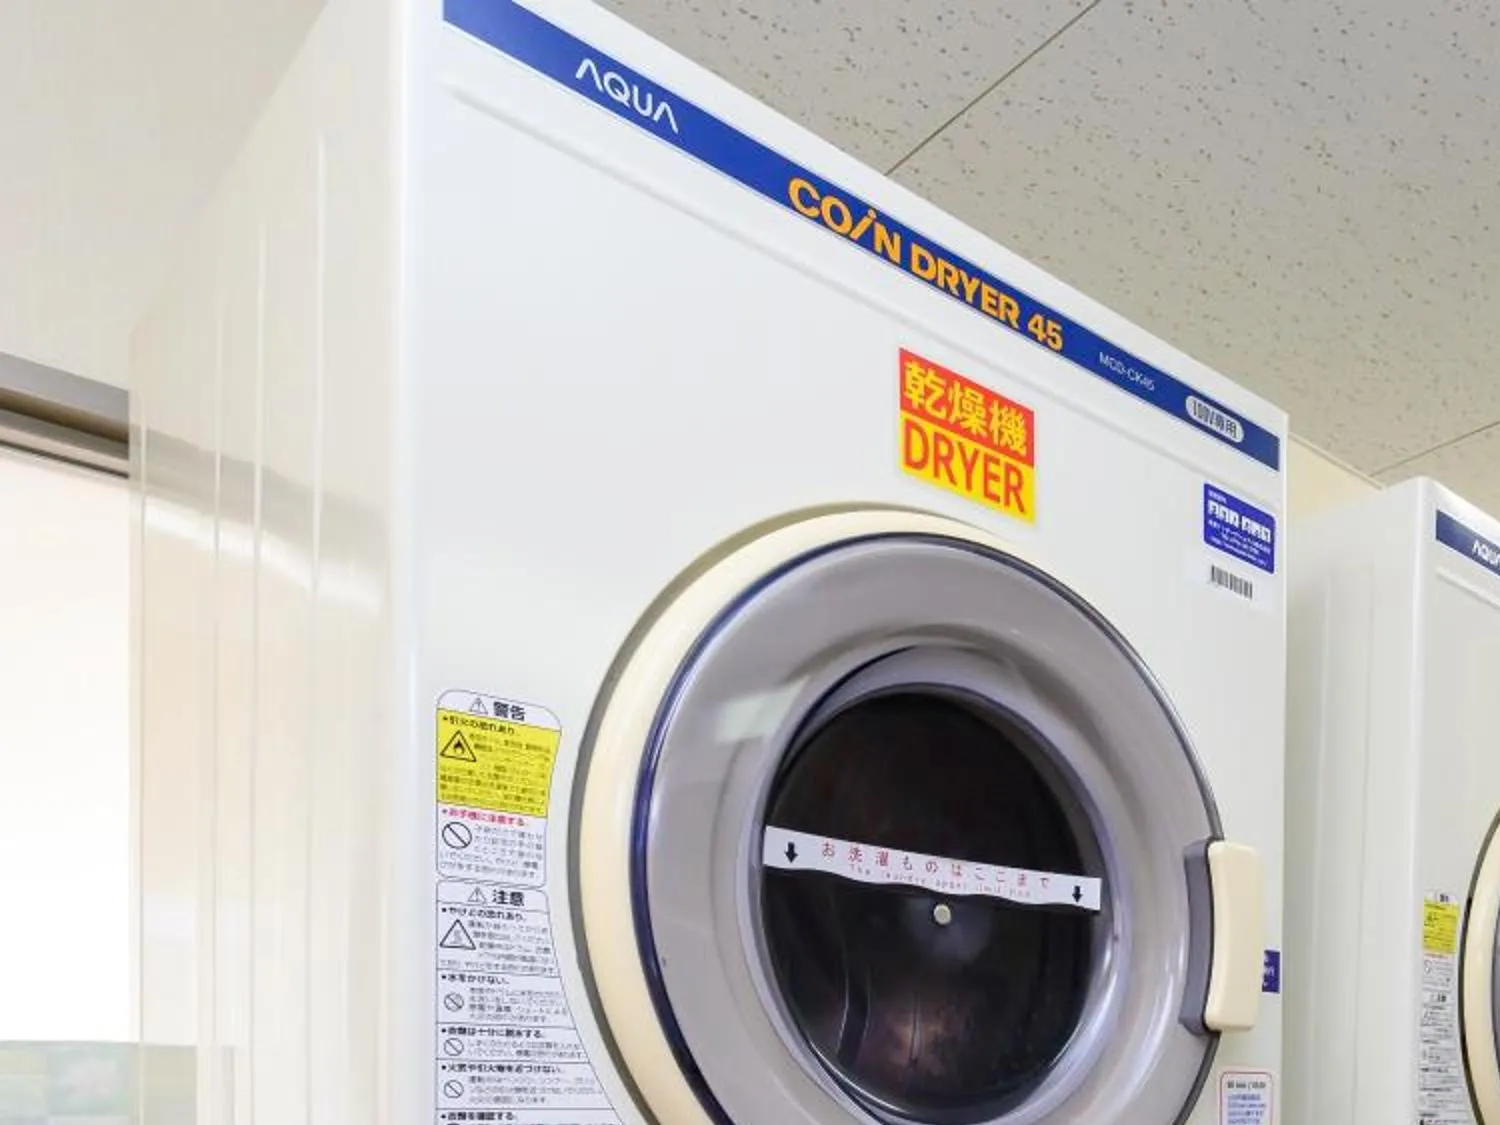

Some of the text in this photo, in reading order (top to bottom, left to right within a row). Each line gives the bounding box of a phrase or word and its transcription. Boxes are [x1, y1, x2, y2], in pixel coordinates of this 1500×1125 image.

[574, 57, 679, 134] AQUA
[910, 240, 1019, 330] DRYER
[1028, 309, 1065, 352] 45
[904, 356, 1029, 458] 乾燥機
[903, 427, 1027, 515] DRYER
